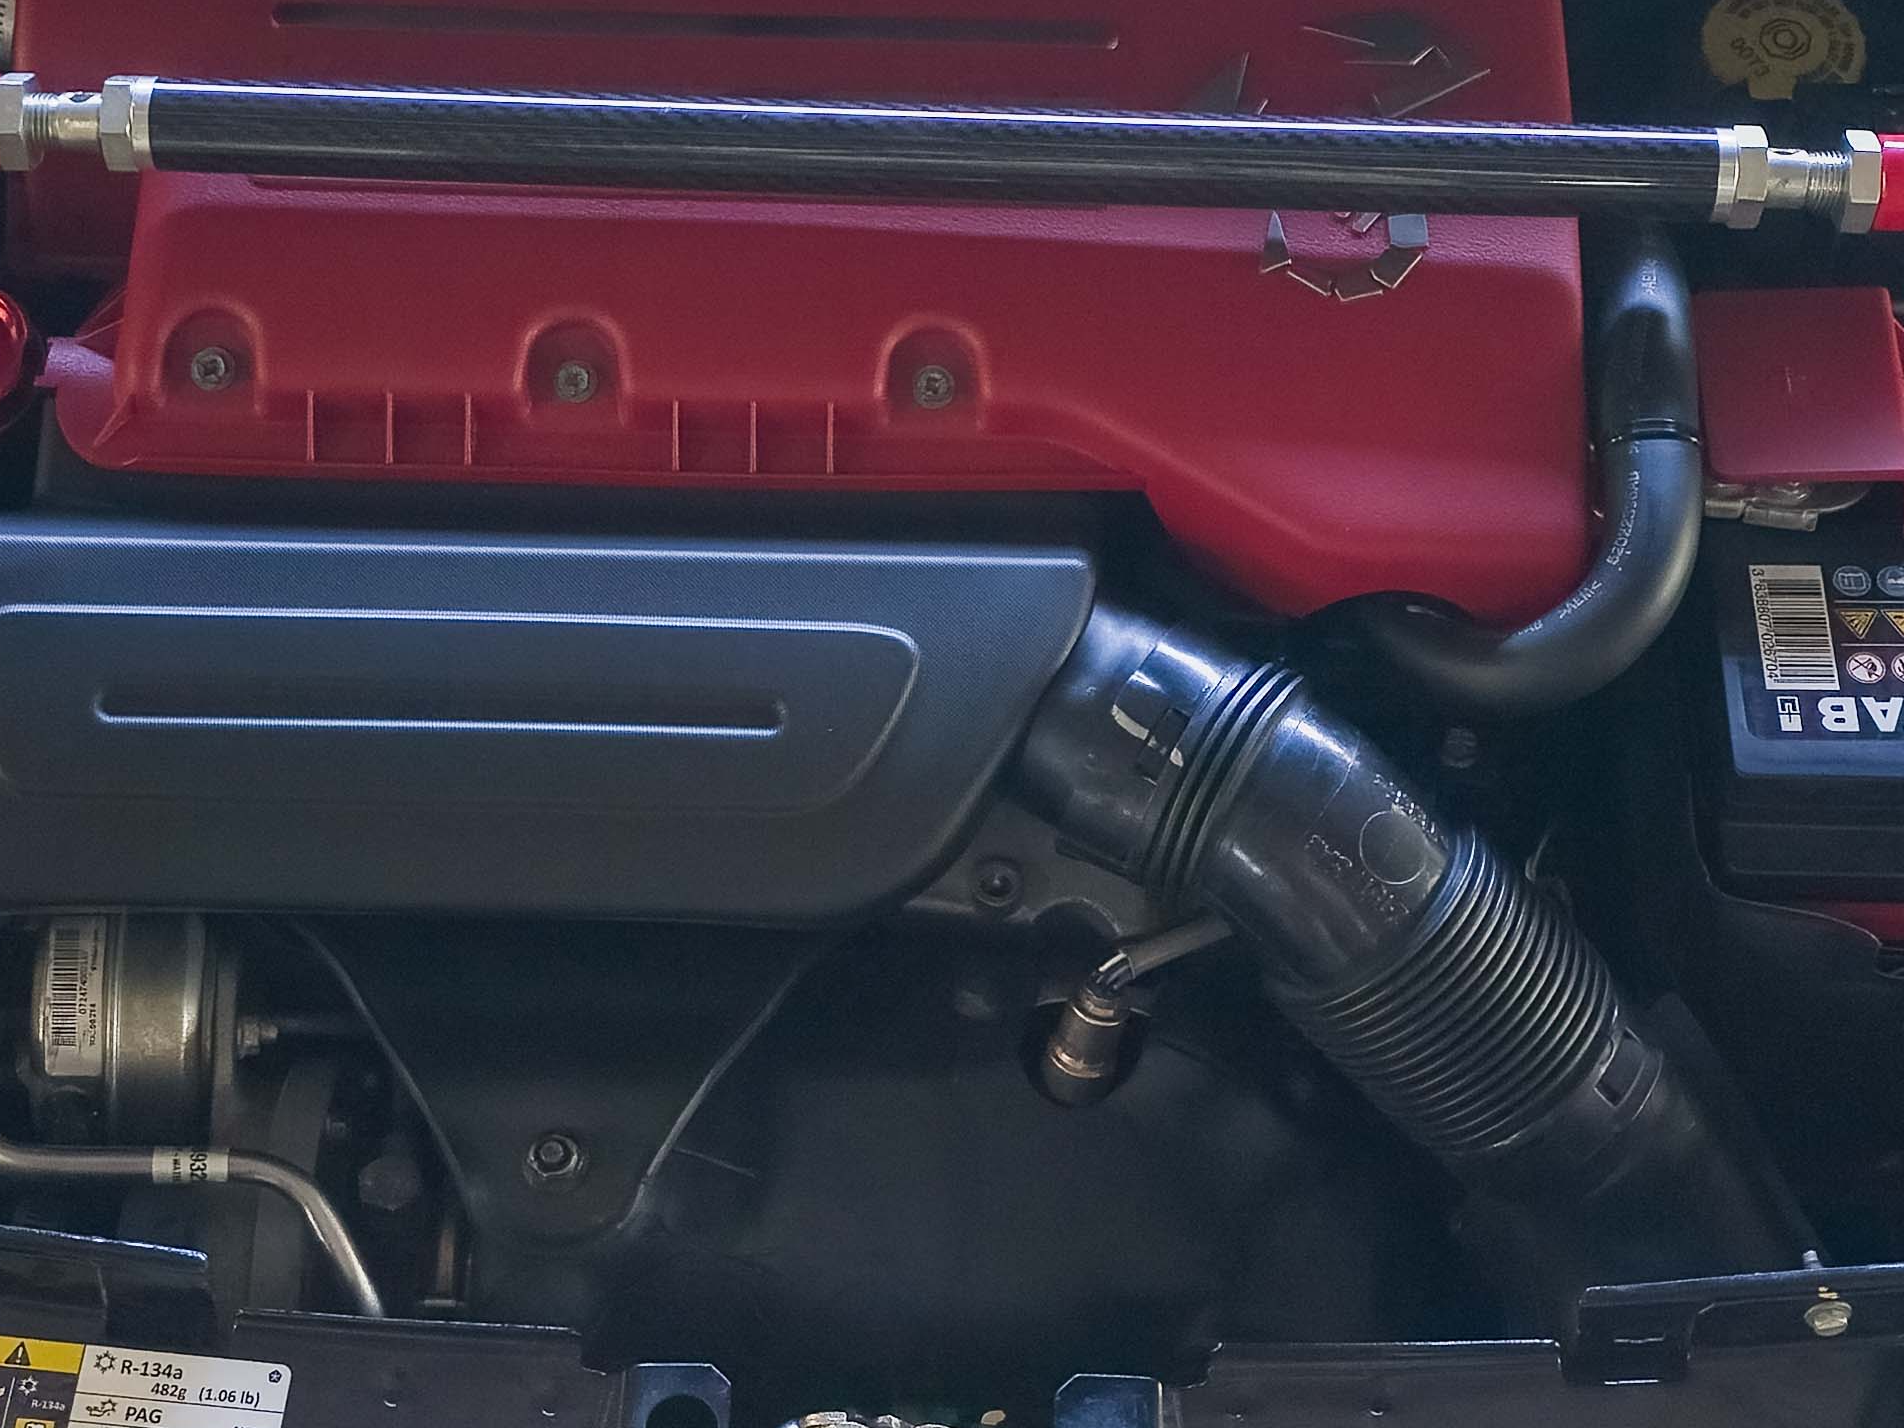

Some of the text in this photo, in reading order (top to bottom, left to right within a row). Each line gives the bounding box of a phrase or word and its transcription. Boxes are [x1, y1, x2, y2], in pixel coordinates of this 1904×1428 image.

[120, 1359, 184, 1381] R-134a
[150, 1383, 261, 1408] 482g (1.06 lb)
[124, 1405, 163, 1425] PAG
